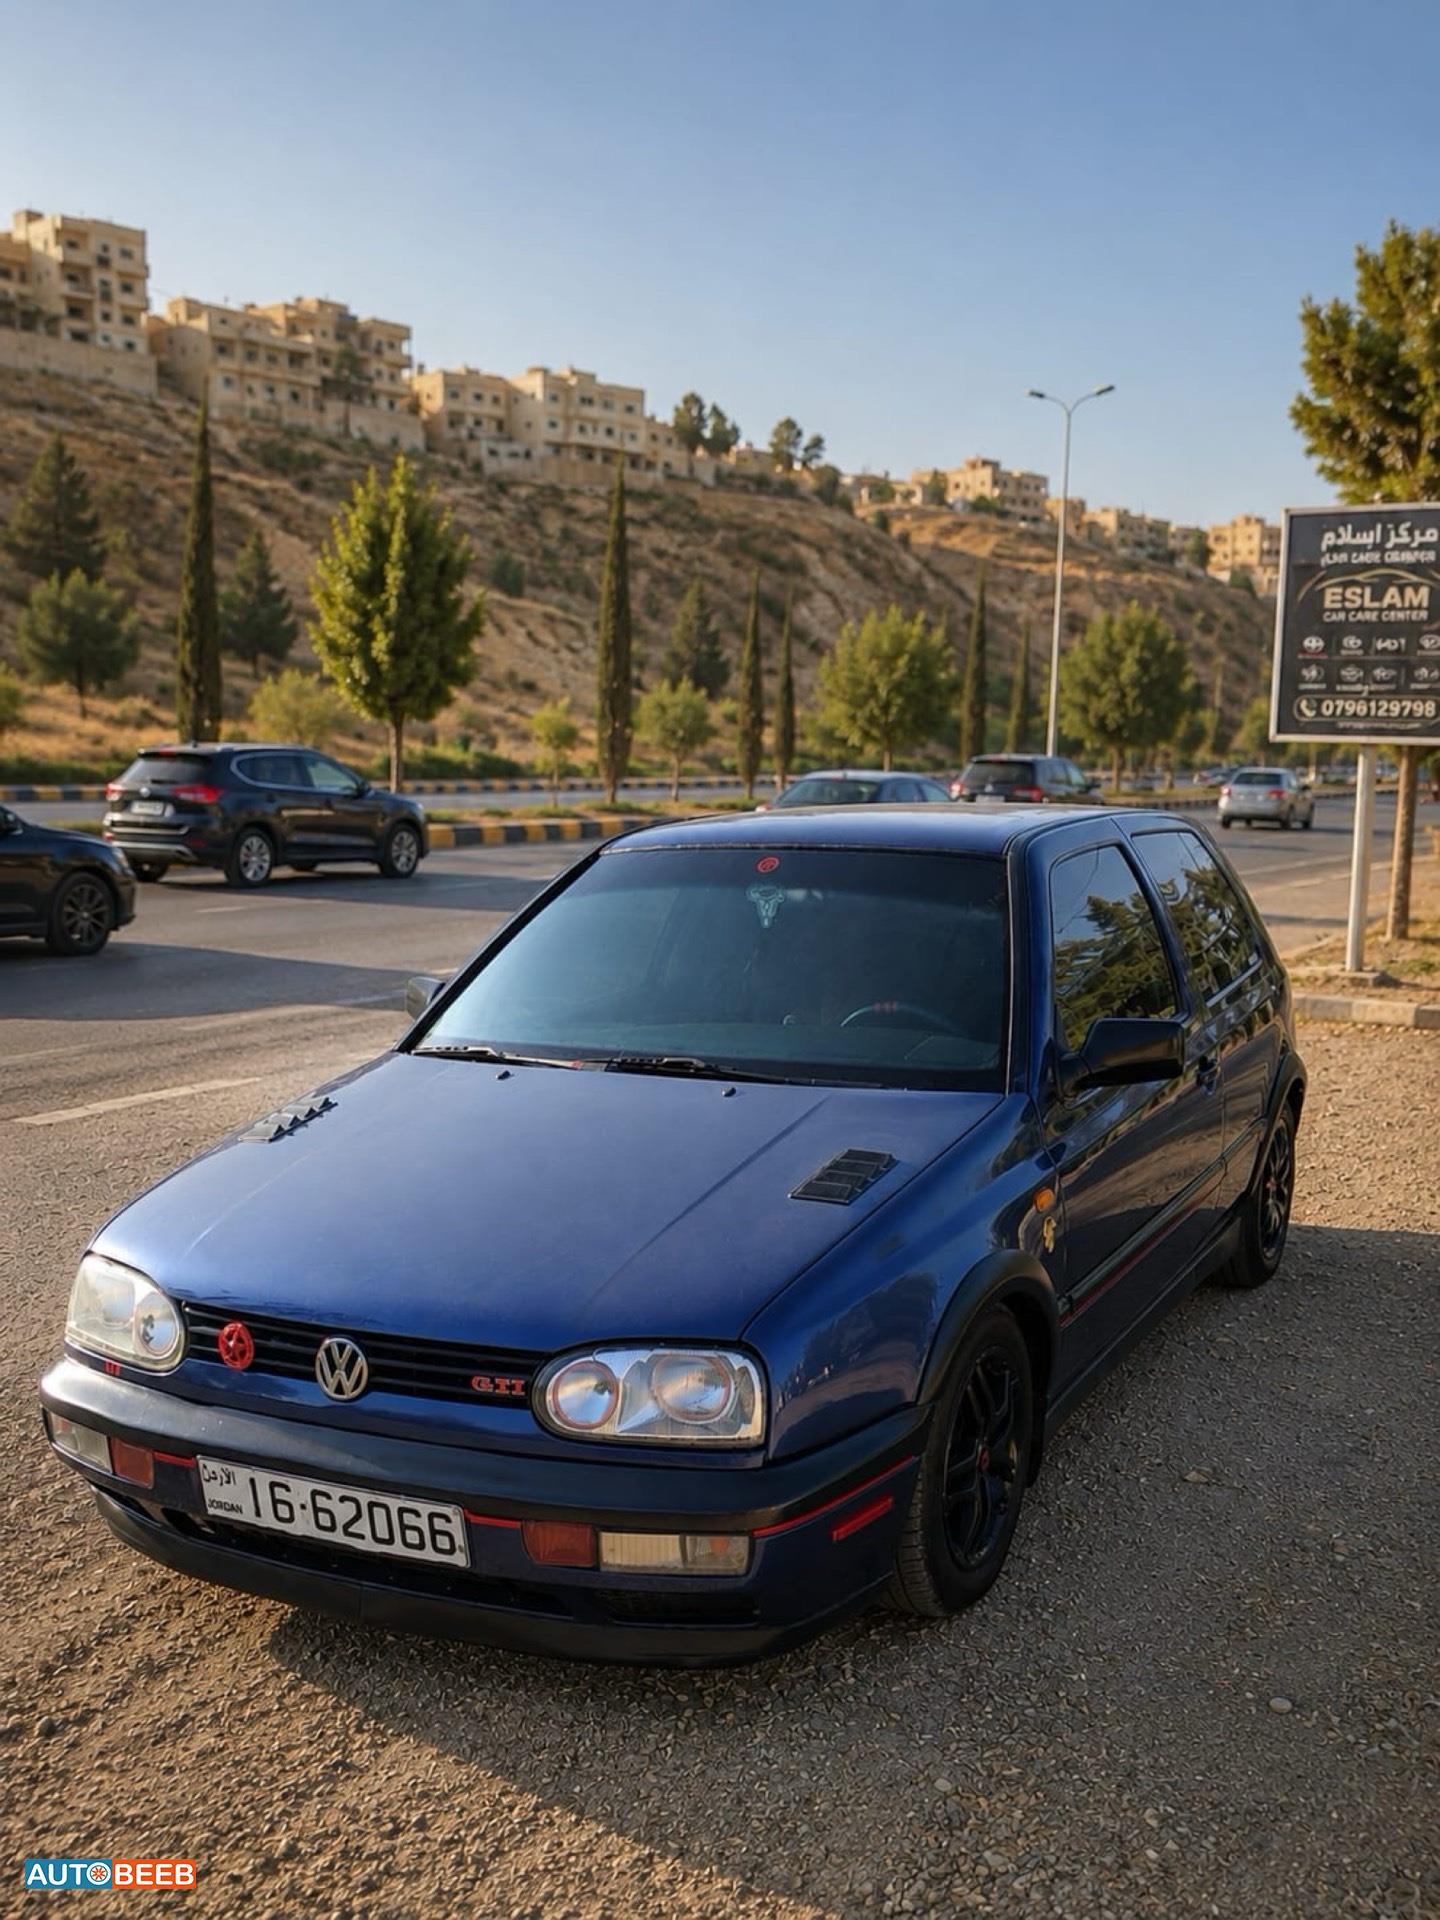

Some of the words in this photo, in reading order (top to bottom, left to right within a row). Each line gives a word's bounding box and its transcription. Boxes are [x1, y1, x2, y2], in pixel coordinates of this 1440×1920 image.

[1384, 521, 1439, 549] مركز
[1323, 586, 1430, 609] ESLAM
[1348, 610, 1379, 622] CARE
[1381, 610, 1429, 622] CENTER
[208, 1498, 243, 1514] JORDAN
